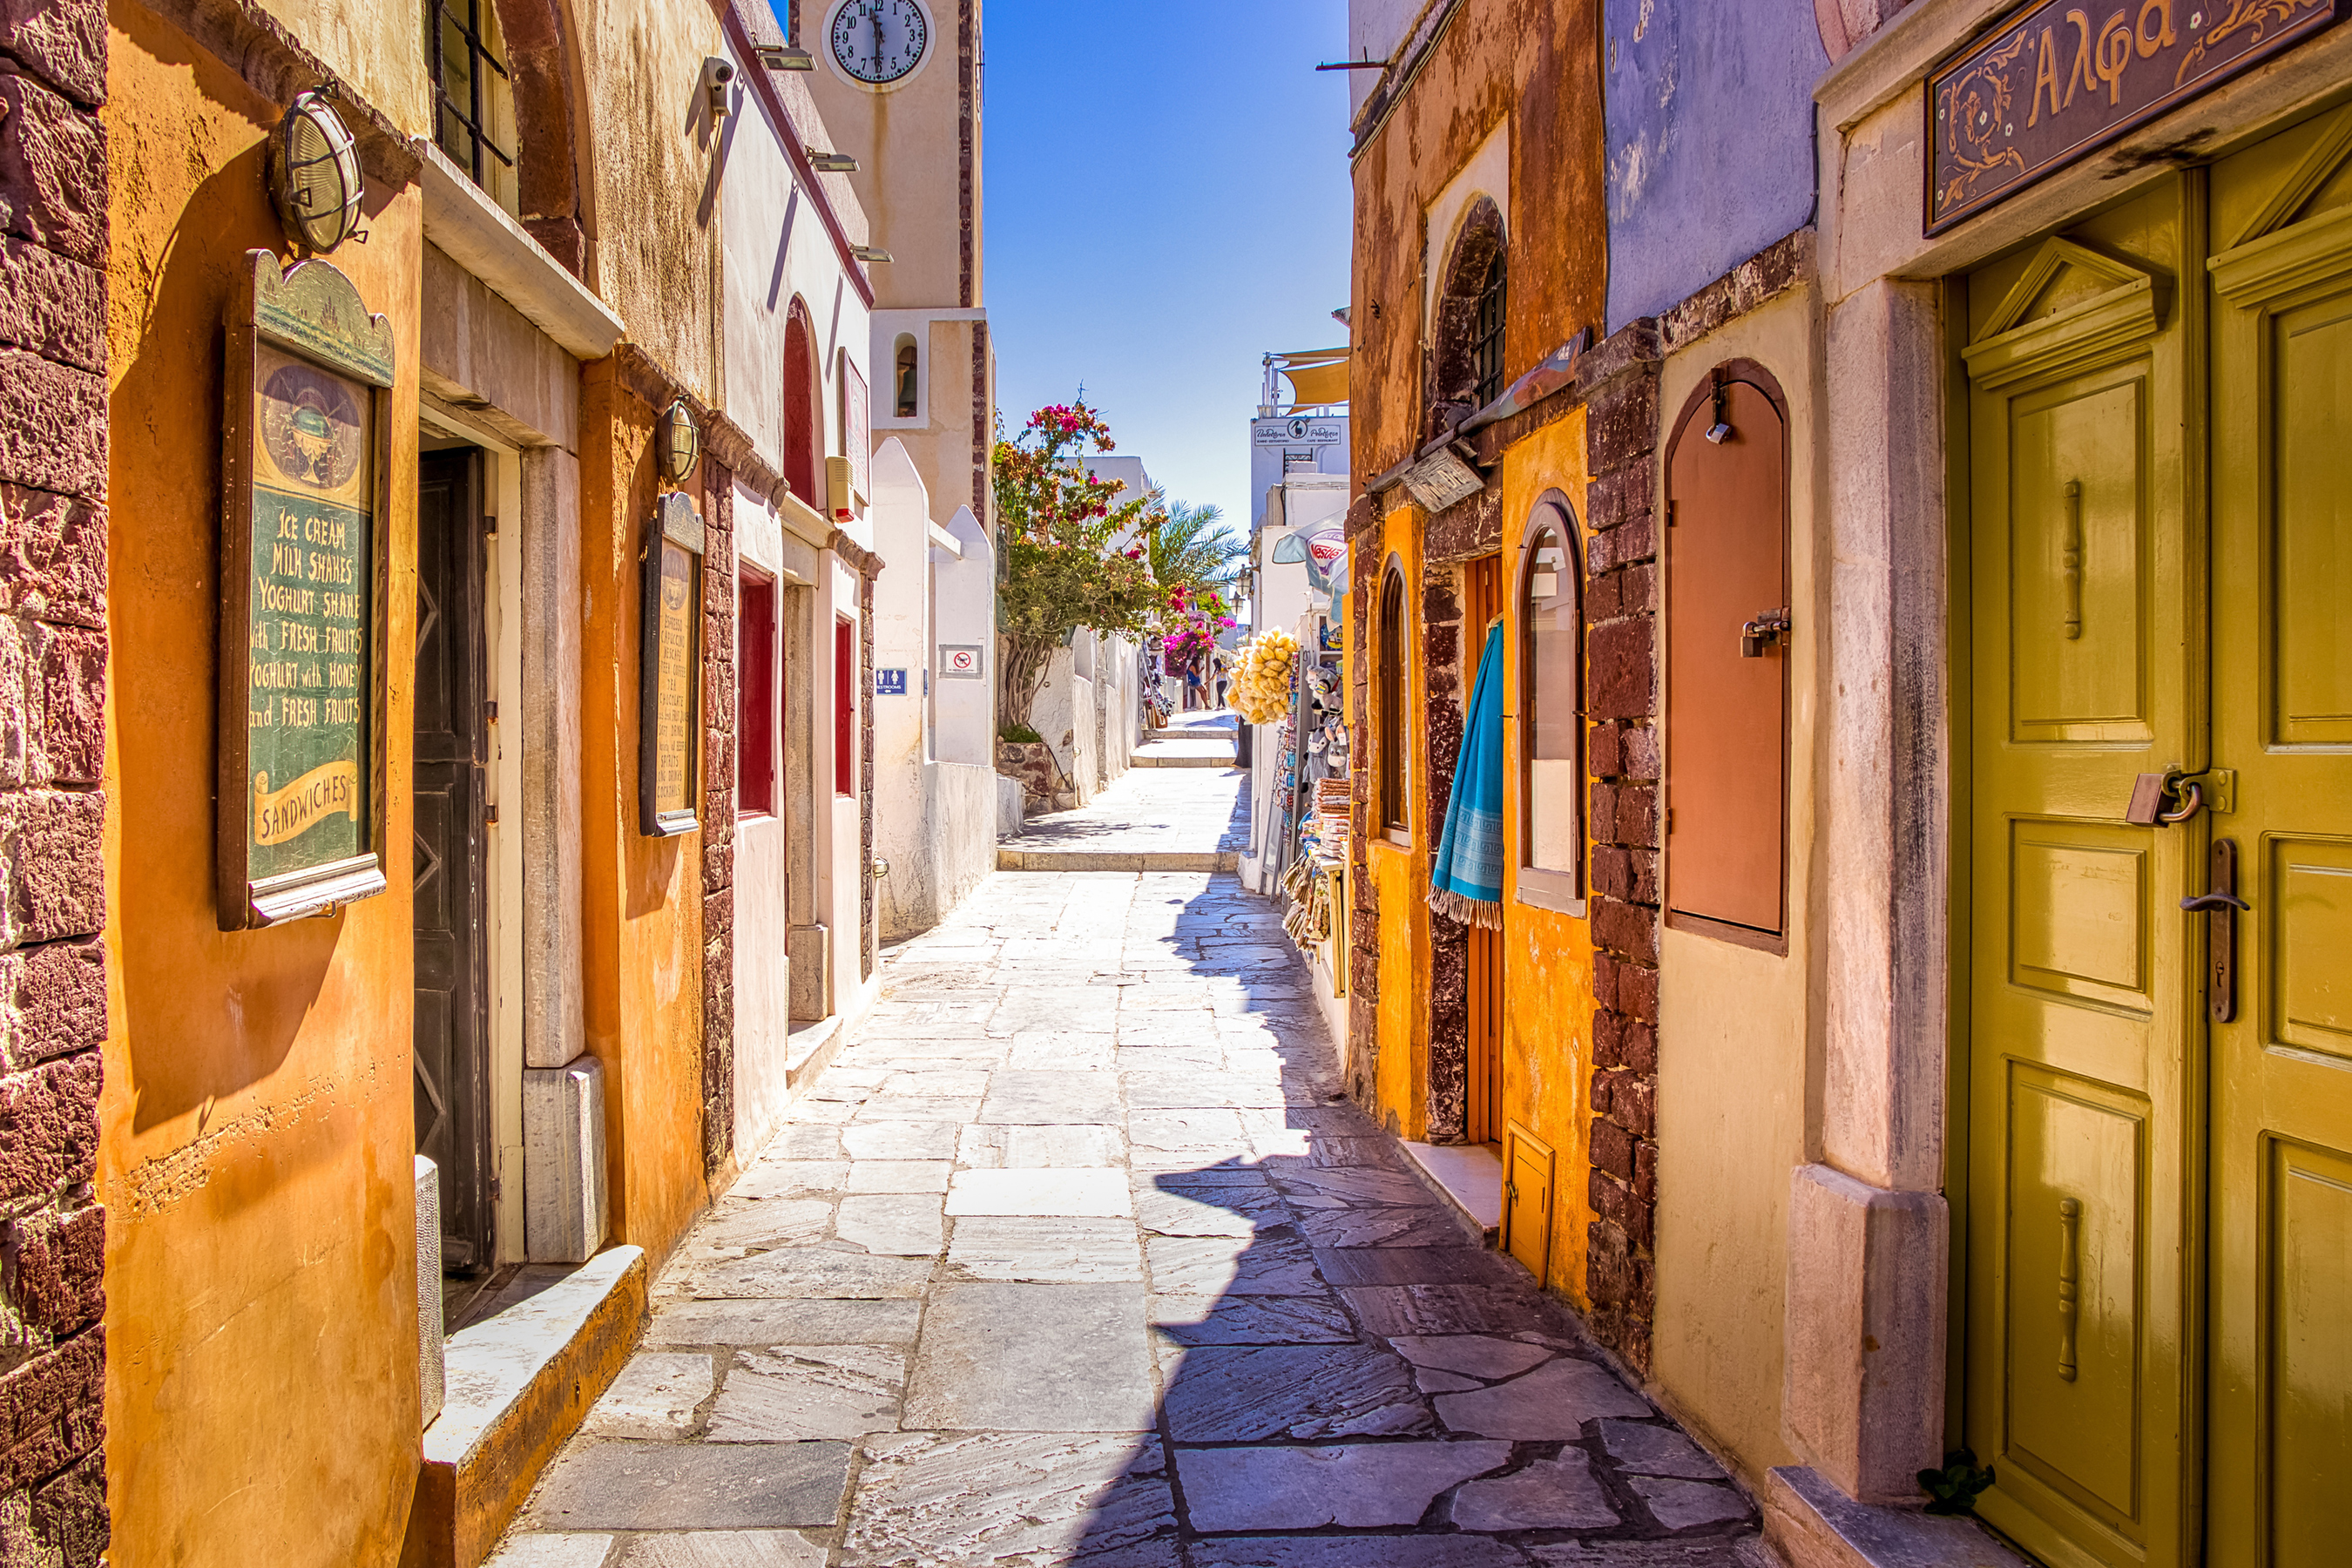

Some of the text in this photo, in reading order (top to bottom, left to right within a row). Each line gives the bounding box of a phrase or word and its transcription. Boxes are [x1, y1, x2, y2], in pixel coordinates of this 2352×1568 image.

[859, 3, 867, 17] 11
[875, 0, 883, 11] 12
[893, 2, 897, 15] 1
[847, 16, 856, 29] 10
[905, 14, 910, 27] 2
[842, 30, 848, 44] 9
[909, 29, 916, 42] 3
[848, 45, 854, 58] 8
[904, 43, 910, 57] 4
[861, 57, 867, 71] 7
[890, 57, 896, 70] 5
[277, 507, 346, 551] ICE CREAM
[270, 542, 353, 585] MILK SHAKES
[258, 576, 361, 620] YOGHURT SHAKE
[664, 614, 682, 632] ESPRESSO
[280, 620, 318, 654] FRESH
[325, 626, 362, 654] FRUITS
[301, 661, 321, 687] with
[329, 662, 362, 691] HONEY
[249, 695, 361, 728] and FRESH FRUITS
[661, 754, 679, 767] SPIRITS
[261, 774, 347, 839] SANDWICHES
